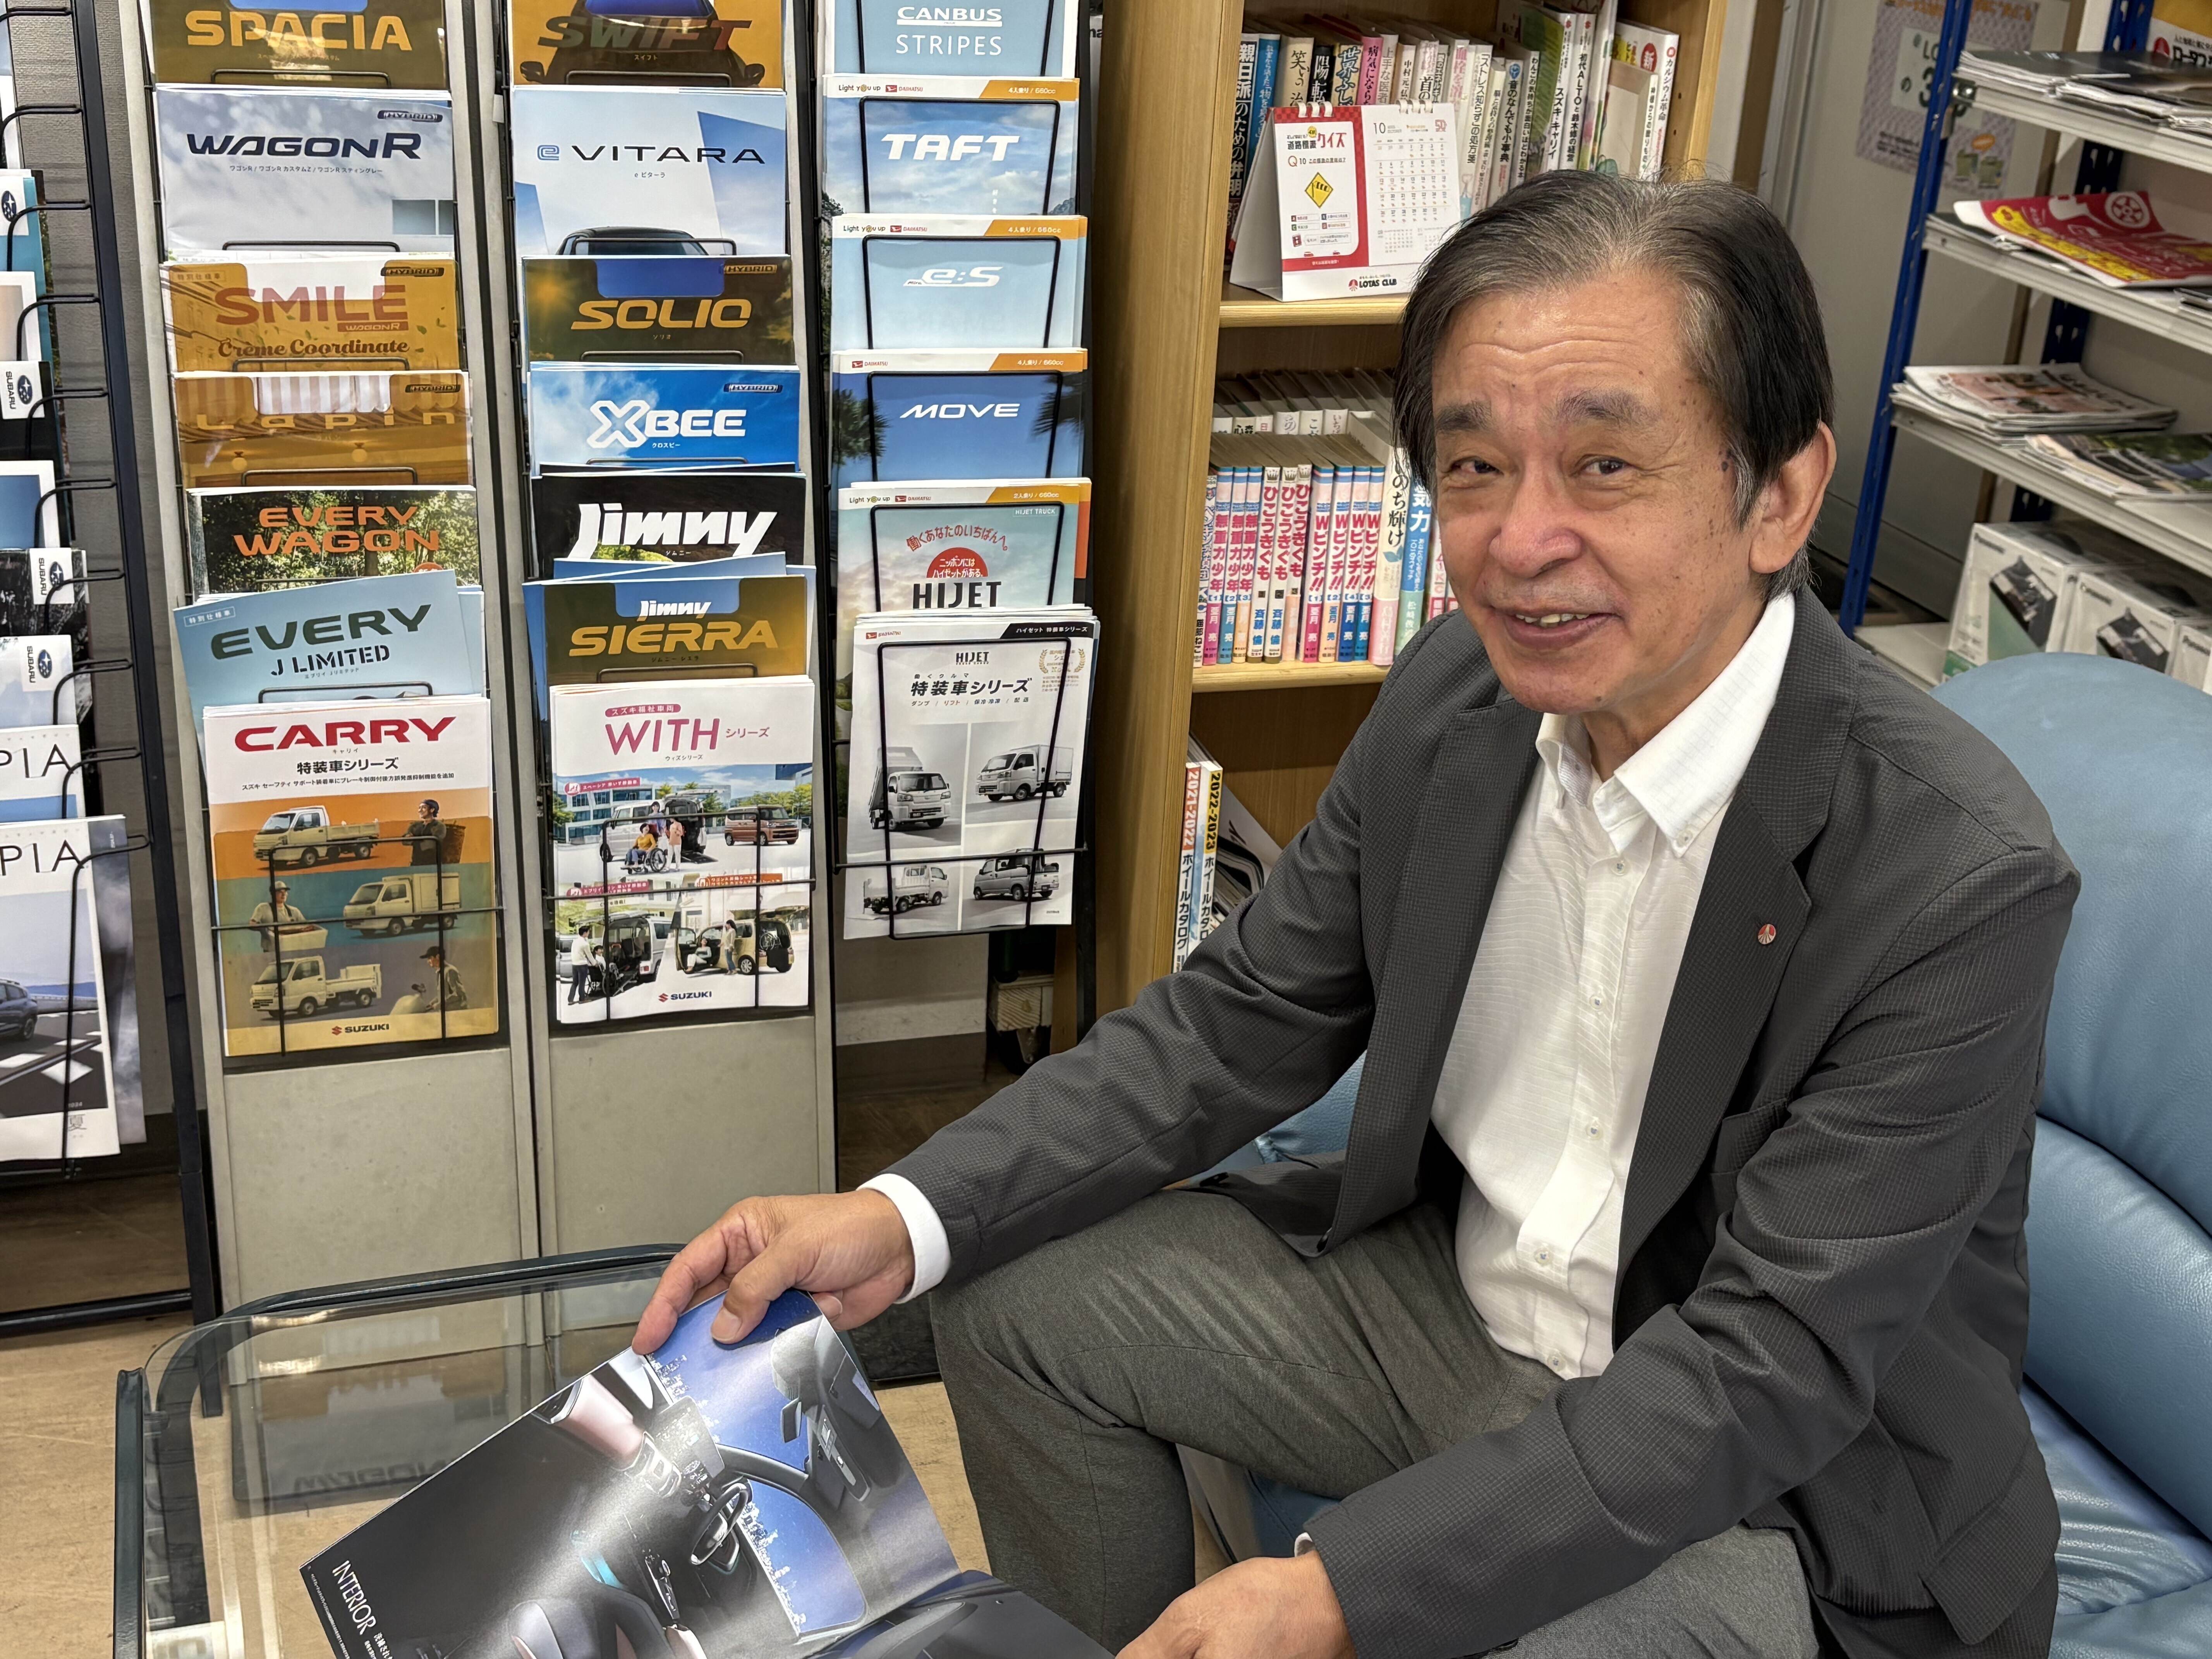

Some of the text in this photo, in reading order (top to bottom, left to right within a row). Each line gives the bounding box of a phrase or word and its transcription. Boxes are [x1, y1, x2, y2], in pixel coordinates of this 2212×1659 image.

[185, 10, 412, 51] SPACIA
[897, 7, 1002, 21] CANBUS
[538, 16, 752, 50] SWIFT
[896, 34, 1002, 55] STRIPES
[838, 84, 854, 93] Light
[1335, 46, 1361, 105] 世界ふし
[1363, 45, 1379, 105] 病気になら
[1317, 132, 1346, 148] クイズ
[1373, 122, 1386, 134] 10
[572, 146, 766, 164] VITARA
[881, 134, 1020, 161] TAFT
[1288, 156, 1297, 167] Q
[1359, 280, 1379, 288] LOTAS
[215, 285, 408, 326] SMILE
[570, 299, 752, 330] SOLIO
[290, 339, 410, 355] Coordinate
[5, 371, 16, 410] SUBARU
[587, 400, 747, 448] XBEE
[900, 403, 1020, 419] MOVE
[259, 506, 418, 527] EVERY
[567, 503, 777, 559] Jimny
[1257, 486, 1278, 581] ひこうきぐも
[1275, 486, 1295, 581] ひこうきぐも
[1290, 484, 1310, 578] ひこうきぐも
[232, 529, 439, 556] WAGON
[1210, 515, 1229, 592] 無重力少年
[1226, 515, 1244, 592] 無重力少年
[1240, 514, 1257, 592] 無重力少年
[39, 557, 47, 596] SUBARU
[939, 556, 975, 567] ニッポンには
[637, 600, 712, 622] Jimny
[912, 581, 1001, 609] HIJET
[211, 604, 431, 660] EVERY
[569, 620, 778, 656] SIERRA
[26, 645, 36, 684] SUBARU
[271, 645, 390, 676] J LIMITED
[956, 651, 989, 663] HIJET
[910, 678, 1032, 697] 特装車シリーズ
[234, 716, 456, 752] CARRY
[605, 718, 770, 755] WITH シリーズ
[297, 757, 399, 775] 特装車シリーズ
[1183, 770, 1199, 847] 2021-2022
[1206, 773, 1221, 850] 2022-2023
[1177, 855, 1194, 950] ホイールカタログ
[1199, 856, 1215, 941] ホイールカタロ
[671, 991, 712, 1000] SUZUKI
[344, 1023, 390, 1034] SUZUKI
[332, 1560, 376, 1635] INTERIOR
